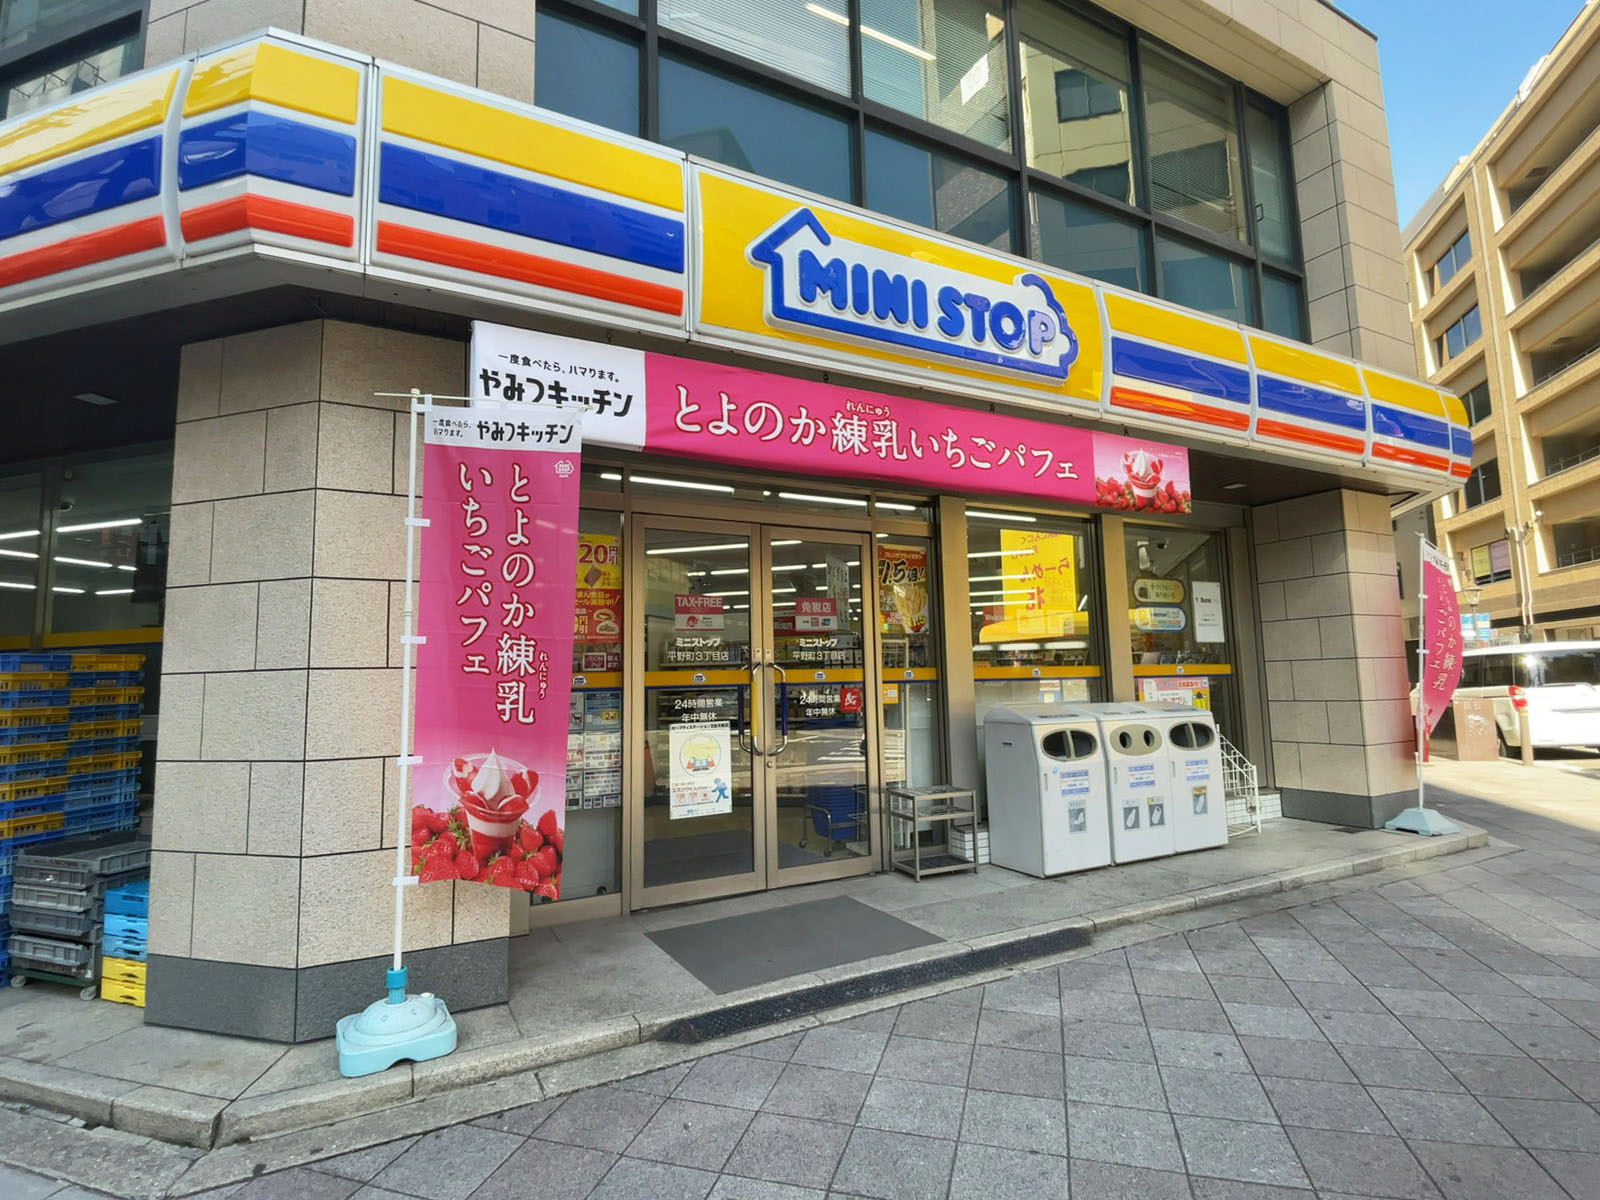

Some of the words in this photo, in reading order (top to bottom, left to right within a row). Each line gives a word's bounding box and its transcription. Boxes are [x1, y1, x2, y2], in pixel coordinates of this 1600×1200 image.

[798, 249, 928, 329] MINI
[936, 285, 1057, 356] STOP
[498, 354, 620, 383] 一度食べたら、ハマります。
[479, 368, 633, 417] やみつキッチン
[845, 400, 891, 417] れんにゅう
[477, 420, 574, 444] やみつキッチン
[675, 386, 1079, 480] とよのか練乳いちごパフェ
[457, 462, 494, 675] いちごパフェ
[496, 463, 537, 725] とよのか練乳
[676, 596, 723, 608] TAX-FREE
[676, 637, 721, 647] ミニストップ
[799, 638, 838, 648] ミニストップ
[667, 651, 729, 661] 平野町3丁目店
[793, 651, 846, 661] 平野町3丁目店
[538, 651, 549, 700] れんにゅう
[674, 698, 723, 709] 24時間営業
[805, 707, 836, 717] 年中無休
[681, 712, 717, 722] 年中無休
